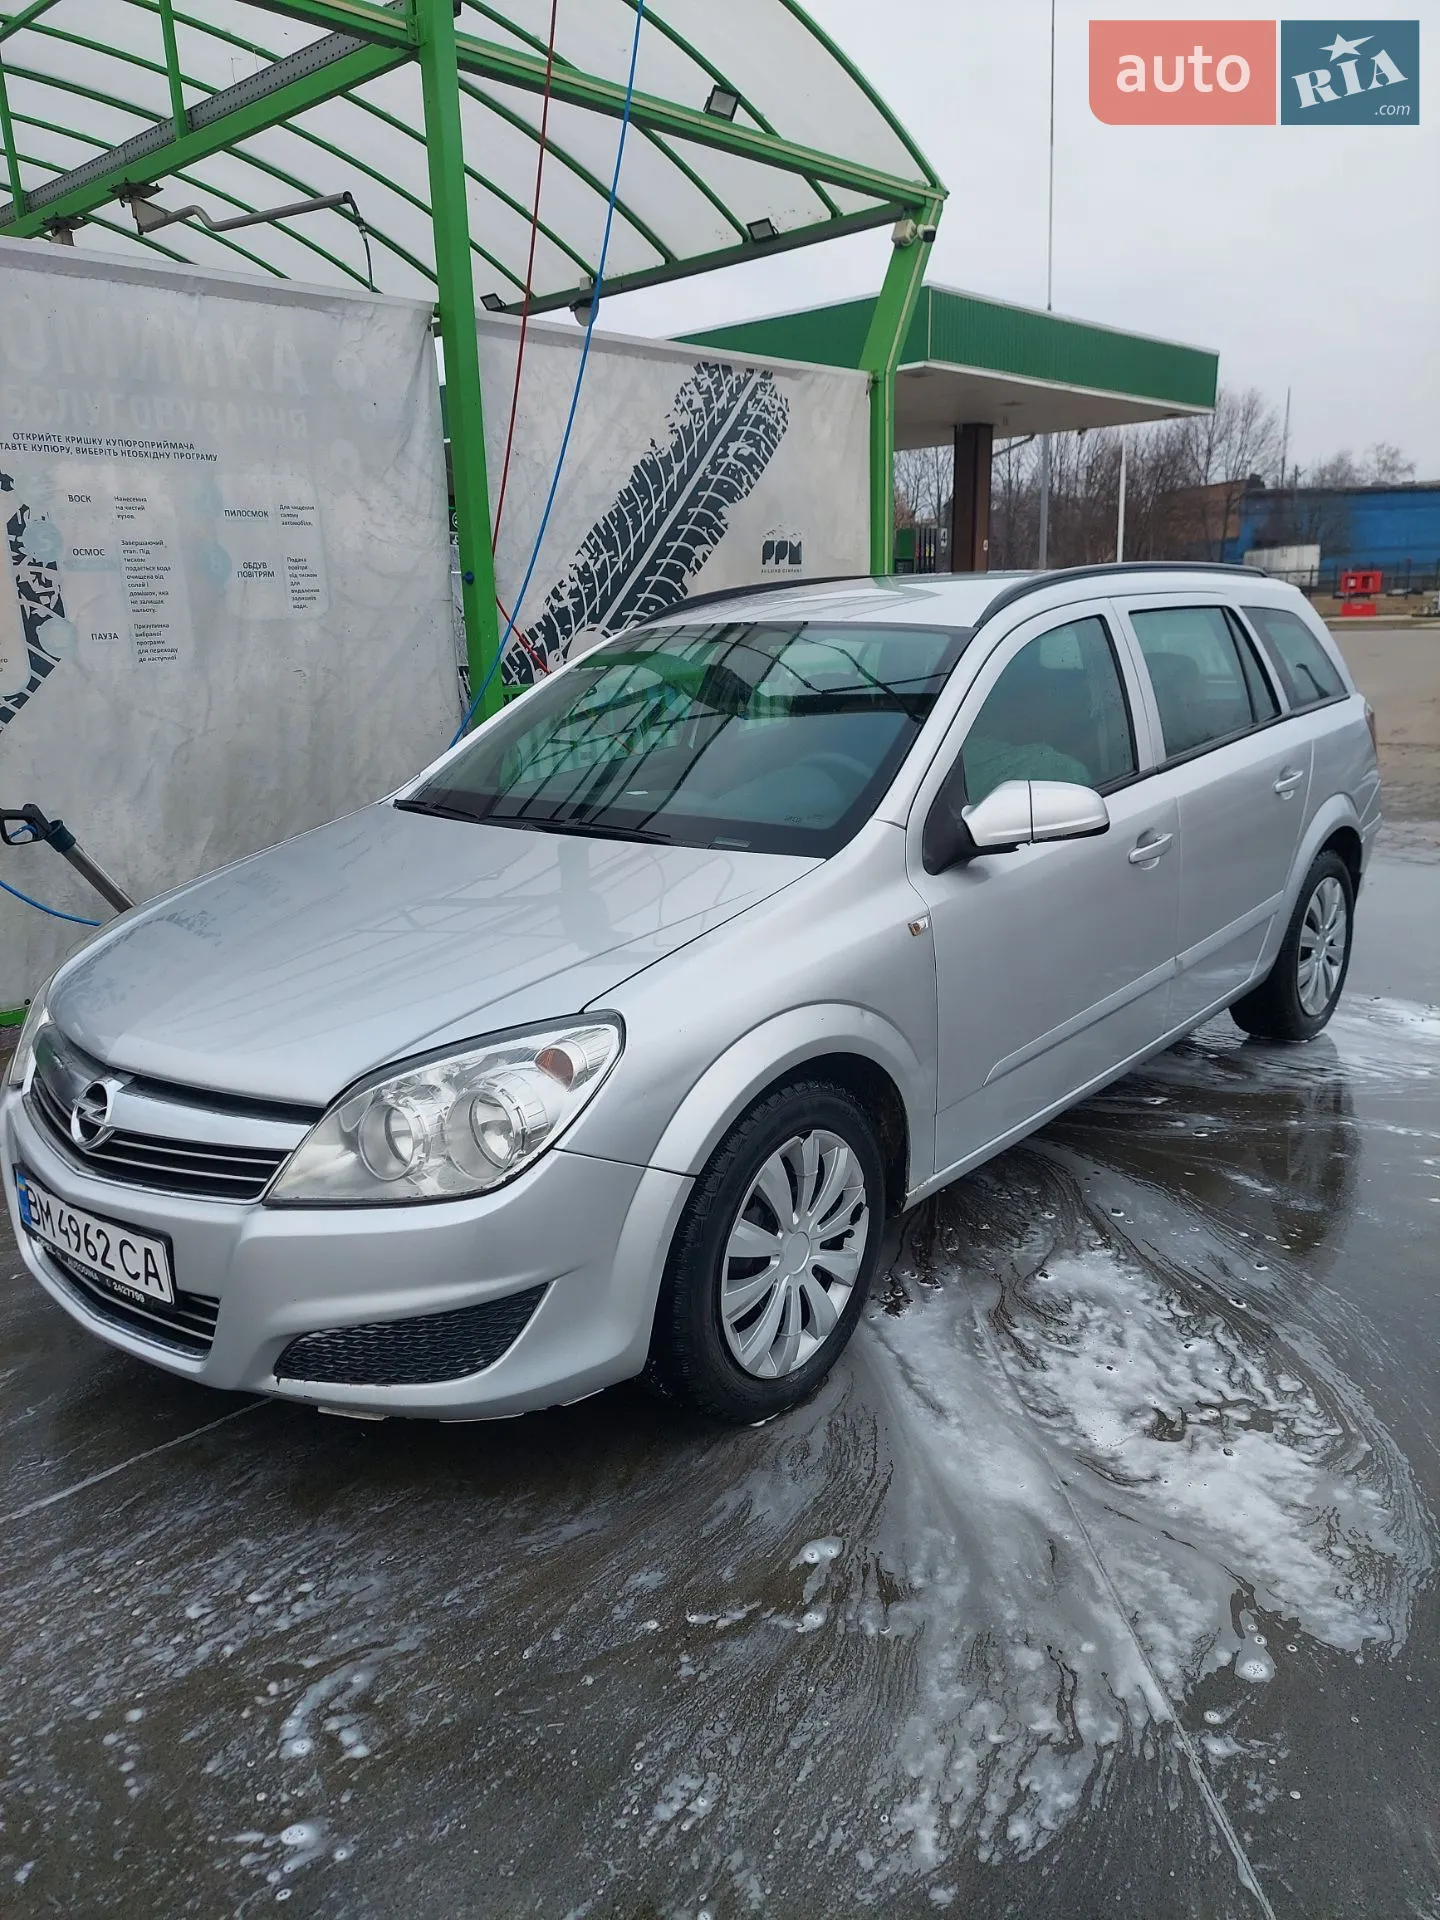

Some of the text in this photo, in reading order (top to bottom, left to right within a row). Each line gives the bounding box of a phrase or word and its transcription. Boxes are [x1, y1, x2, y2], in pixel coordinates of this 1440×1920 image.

[12, 432, 195, 450] ОТКРИЙТЕ КРИШКУ КУПЮРОПРИЙМАЧА
[31, 444, 73, 455] КУПЮРУ,
[75, 446, 119, 457] ВИБЕРІТЬ
[121, 449, 171, 461] НЕОБХІДНУ
[173, 451, 218, 462] ПРОГРАМУ
[68, 494, 92, 503] ВОСК
[224, 509, 269, 518] ПИЛОСМОК
[72, 548, 105, 556] ОСМОС
[242, 561, 267, 570] ОБДУВ
[91, 632, 119, 640] ПАУЗА
[58, 1208, 116, 1272] 4962
[119, 1238, 165, 1293] CA
